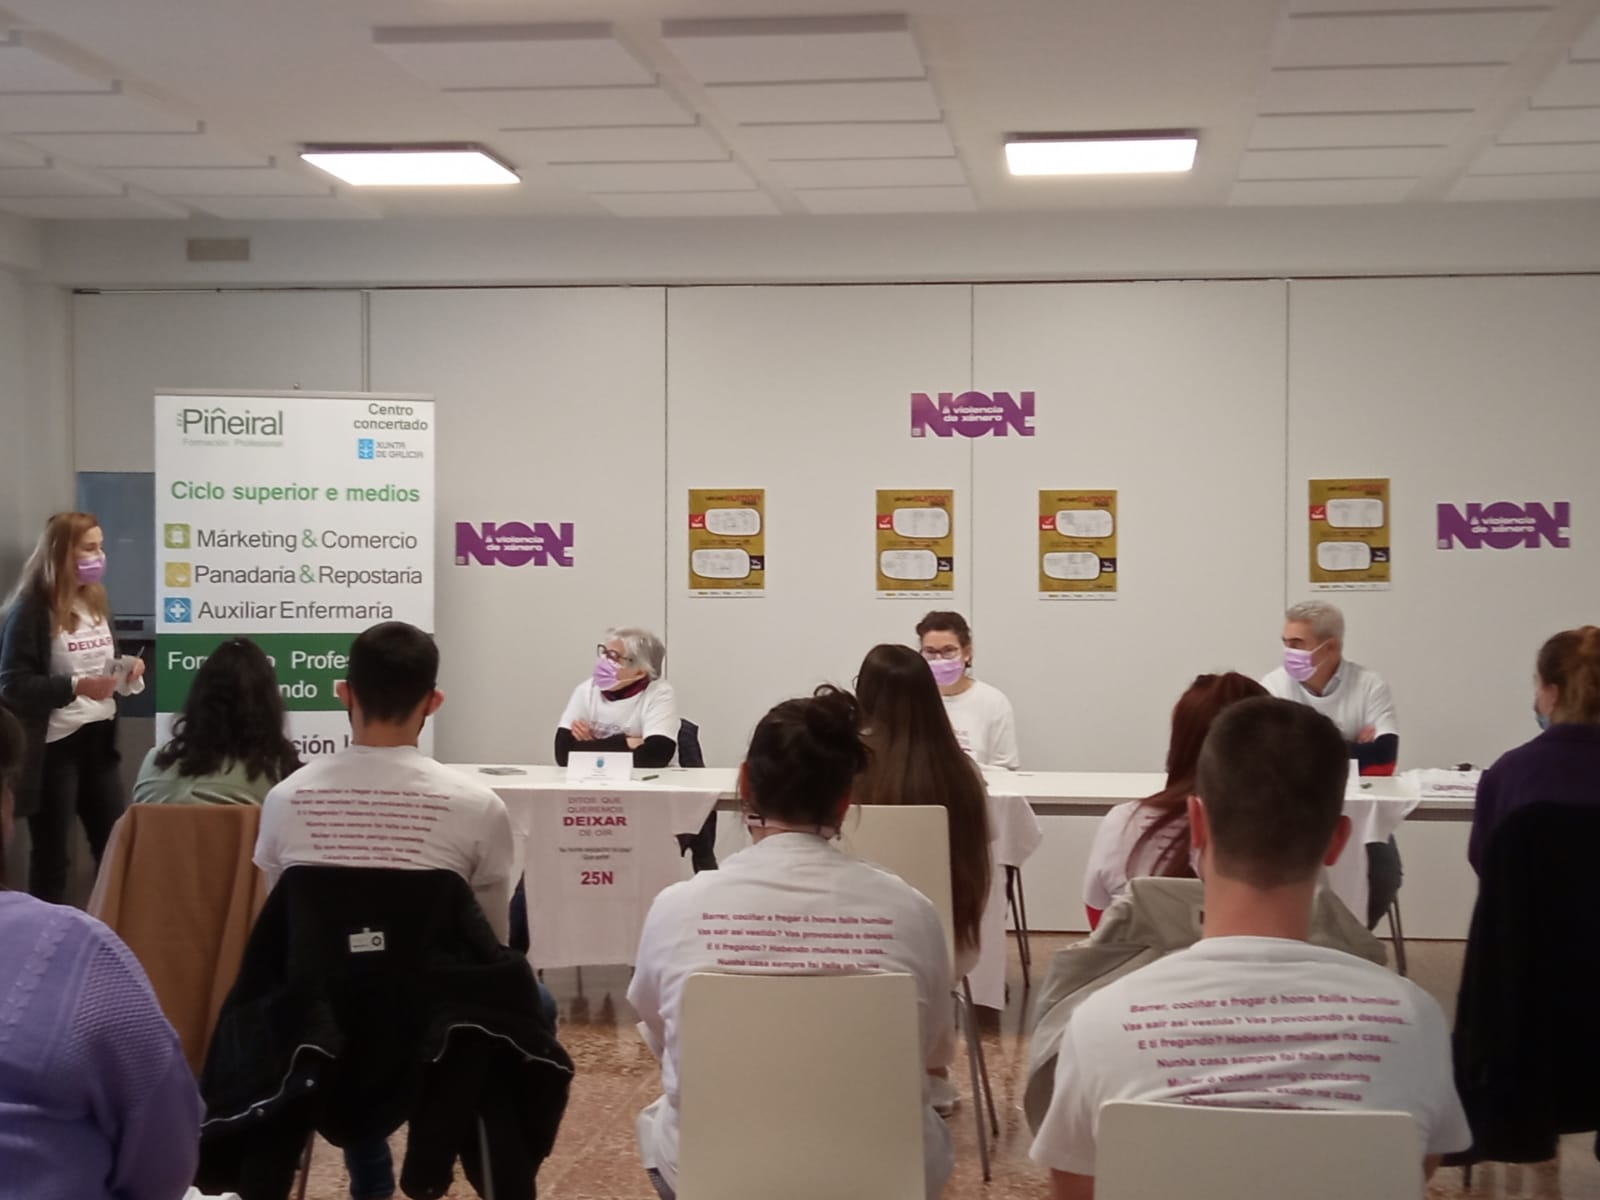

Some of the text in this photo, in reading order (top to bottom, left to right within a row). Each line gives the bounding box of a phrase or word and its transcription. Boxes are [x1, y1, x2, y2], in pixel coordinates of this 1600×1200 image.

[368, 403, 414, 416] Centro
[911, 391, 1035, 438] NON
[353, 419, 429, 431] concertado
[171, 481, 421, 504] Ciclo superior e medios
[1437, 501, 1570, 549] NON
[197, 530, 298, 553] Márketing
[321, 530, 418, 549] Comercio
[455, 522, 574, 567] NON
[198, 601, 394, 619] Auxiliar Enfermaría
[563, 816, 628, 826] DEIXAR
[581, 870, 613, 885] 25N
[1270, 1013, 1344, 1025] provocando
[1199, 1057, 1228, 1066] casa
